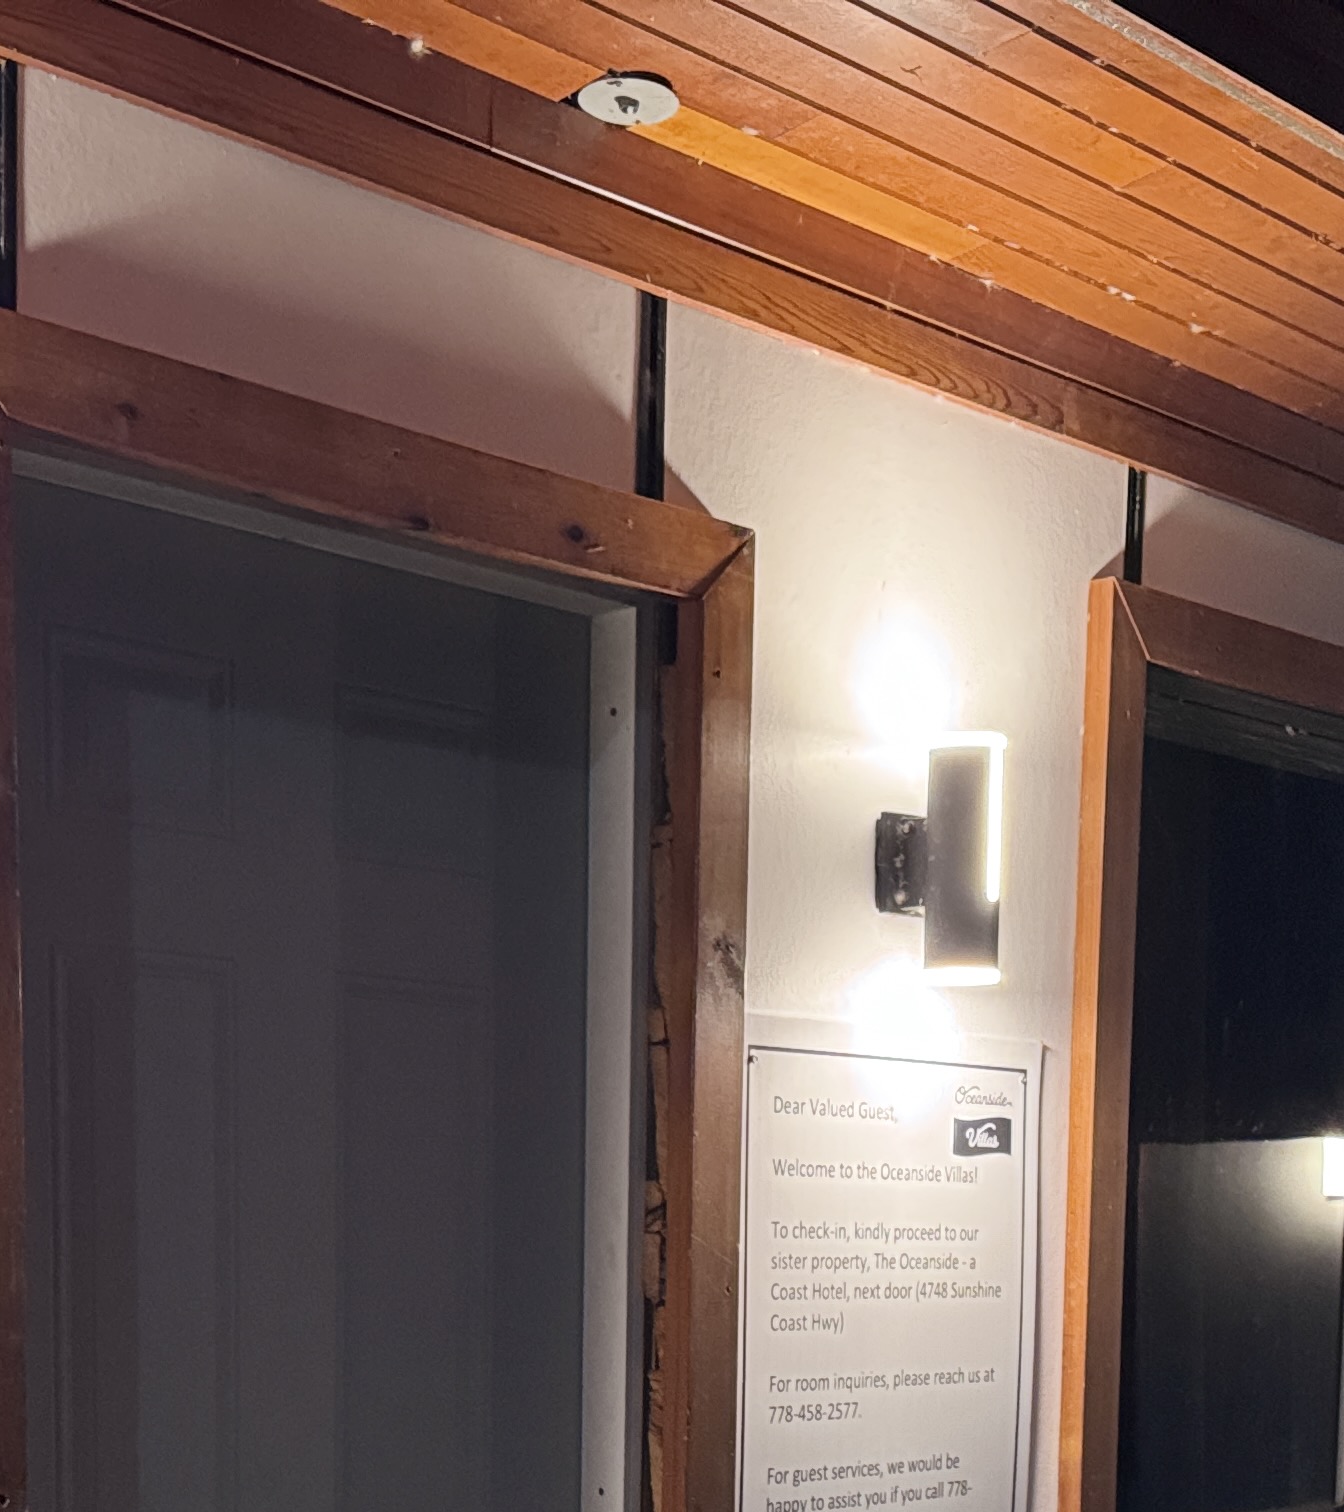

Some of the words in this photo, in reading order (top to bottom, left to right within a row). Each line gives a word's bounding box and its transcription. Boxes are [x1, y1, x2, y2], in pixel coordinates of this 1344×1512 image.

[954, 1085, 1013, 1107] Oceanside
[773, 1095, 806, 1115] Dear
[809, 1098, 855, 1118] Valued
[858, 1101, 898, 1124] Guest,
[965, 1122, 1000, 1149] Villas
[772, 1158, 835, 1179] Welcome
[839, 1162, 853, 1180] to
[856, 1161, 878, 1181] the
[880, 1162, 942, 1183] Oceanside
[945, 1165, 978, 1184] Villas!
[770, 1220, 789, 1240] To
[792, 1220, 850, 1243] check-in,
[854, 1220, 891, 1245] kindly
[893, 1223, 942, 1245] proceed
[944, 1226, 957, 1241] to
[959, 1228, 979, 1242] our
[770, 1251, 808, 1270] sister
[811, 1254, 871, 1274] property,
[874, 1252, 897, 1270] The
[899, 1252, 960, 1271] Oceanside
[969, 1256, 976, 1270] a
[770, 1282, 809, 1301] Coast
[812, 1281, 850, 1303] Hotel,
[853, 1283, 882, 1300] next
[883, 1281, 913, 1300] door
[916, 1280, 949, 1303] (4748
[950, 1280, 1002, 1299] Sunshine
[770, 1313, 808, 1332] Coast
[811, 1311, 845, 1335] Hwy)
[769, 1375, 792, 1394] For
[795, 1376, 830, 1393] room
[833, 1370, 890, 1394] inquiries,
[893, 1368, 931, 1391] please
[933, 1367, 965, 1386] reach
[967, 1369, 981, 1384] us
[983, 1367, 995, 1383] at
[768, 1401, 863, 1425] 778-458-2577.
[767, 1467, 790, 1486] For
[792, 1465, 829, 1488] guest
[831, 1460, 884, 1480] services,
[887, 1461, 905, 1475] we
[907, 1453, 943, 1473] would
[945, 1451, 960, 1470] be
[810, 1495, 825, 1512] to
[827, 1490, 862, 1511] assist
[864, 1491, 887, 1511] you
[890, 1485, 899, 1504] if
[900, 1488, 922, 1507] you
[924, 1481, 945, 1500] call
[947, 1480, 973, 1498] 778-
